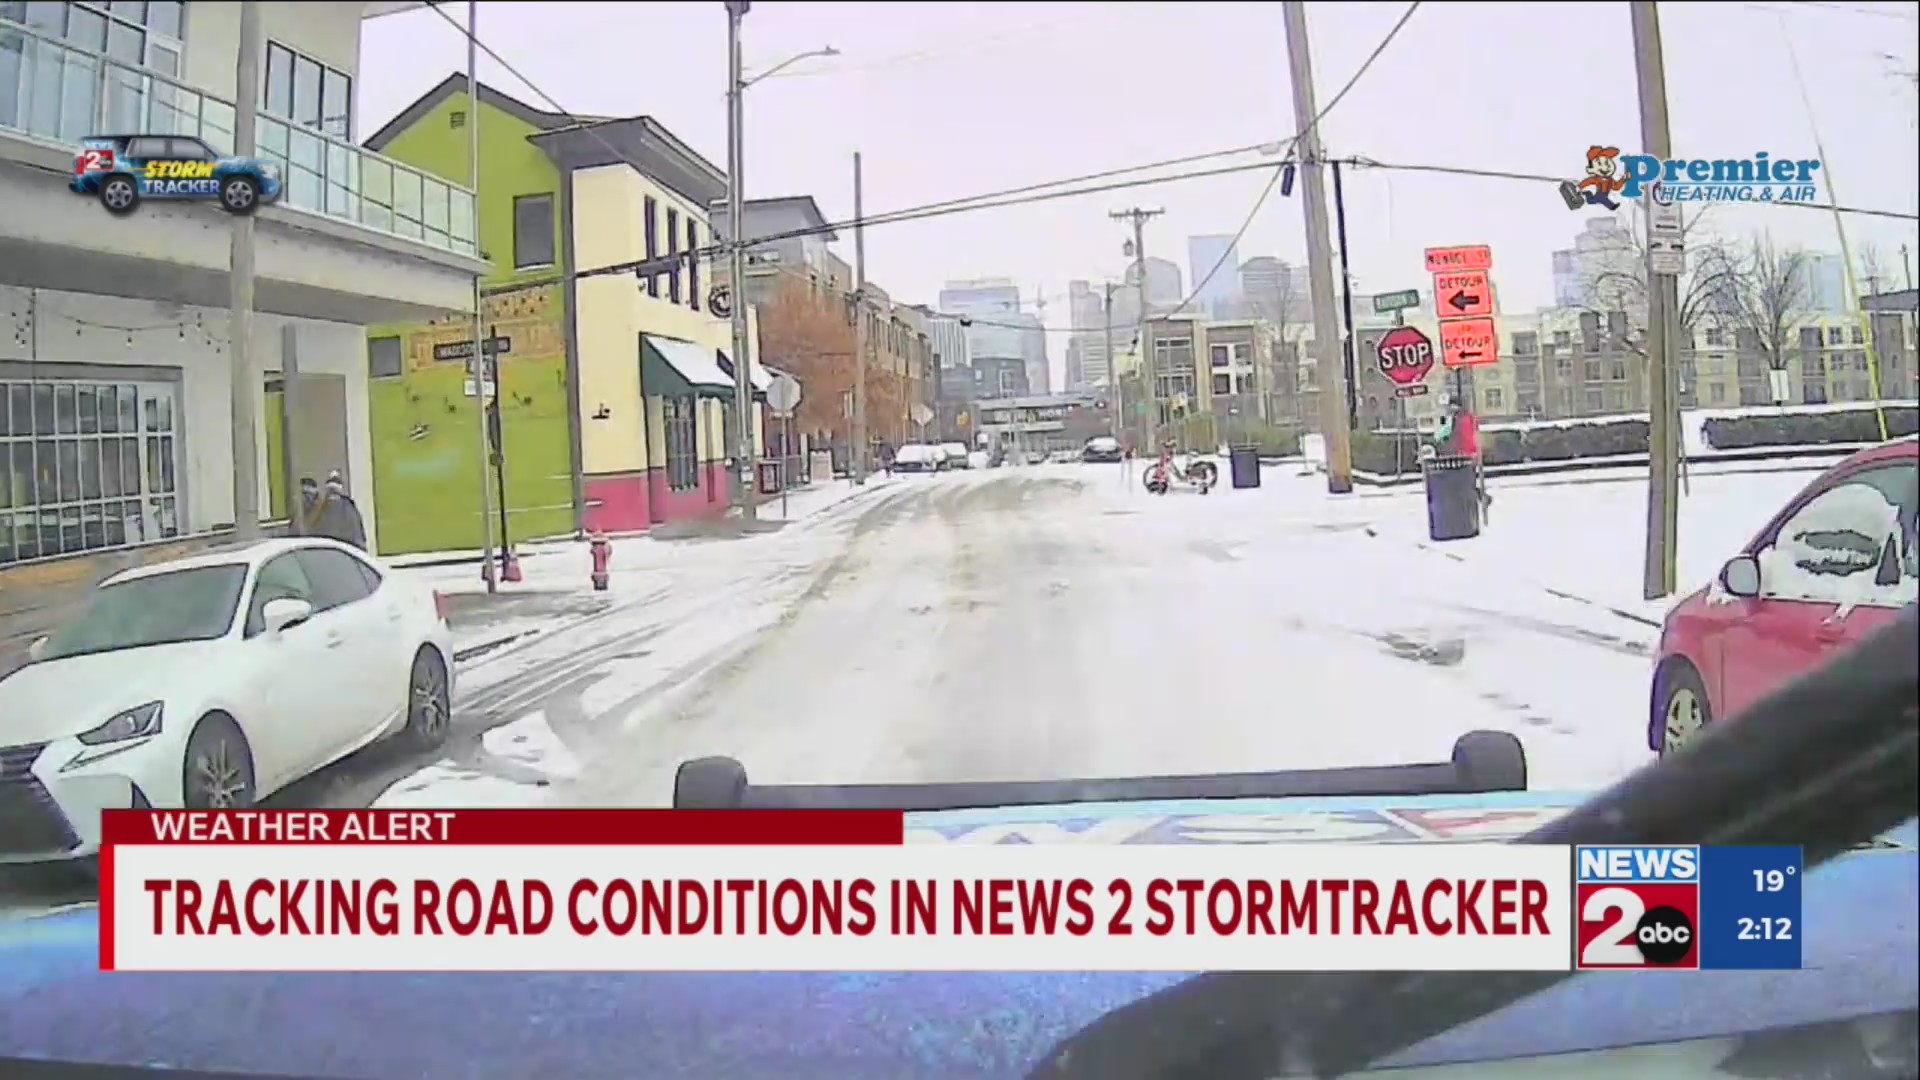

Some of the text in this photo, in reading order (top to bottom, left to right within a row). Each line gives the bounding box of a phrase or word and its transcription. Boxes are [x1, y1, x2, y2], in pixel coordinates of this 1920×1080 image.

[1439, 276, 1484, 290] DETOUR
[1444, 336, 1491, 350] DETOUR
[1380, 342, 1430, 370] STOP
